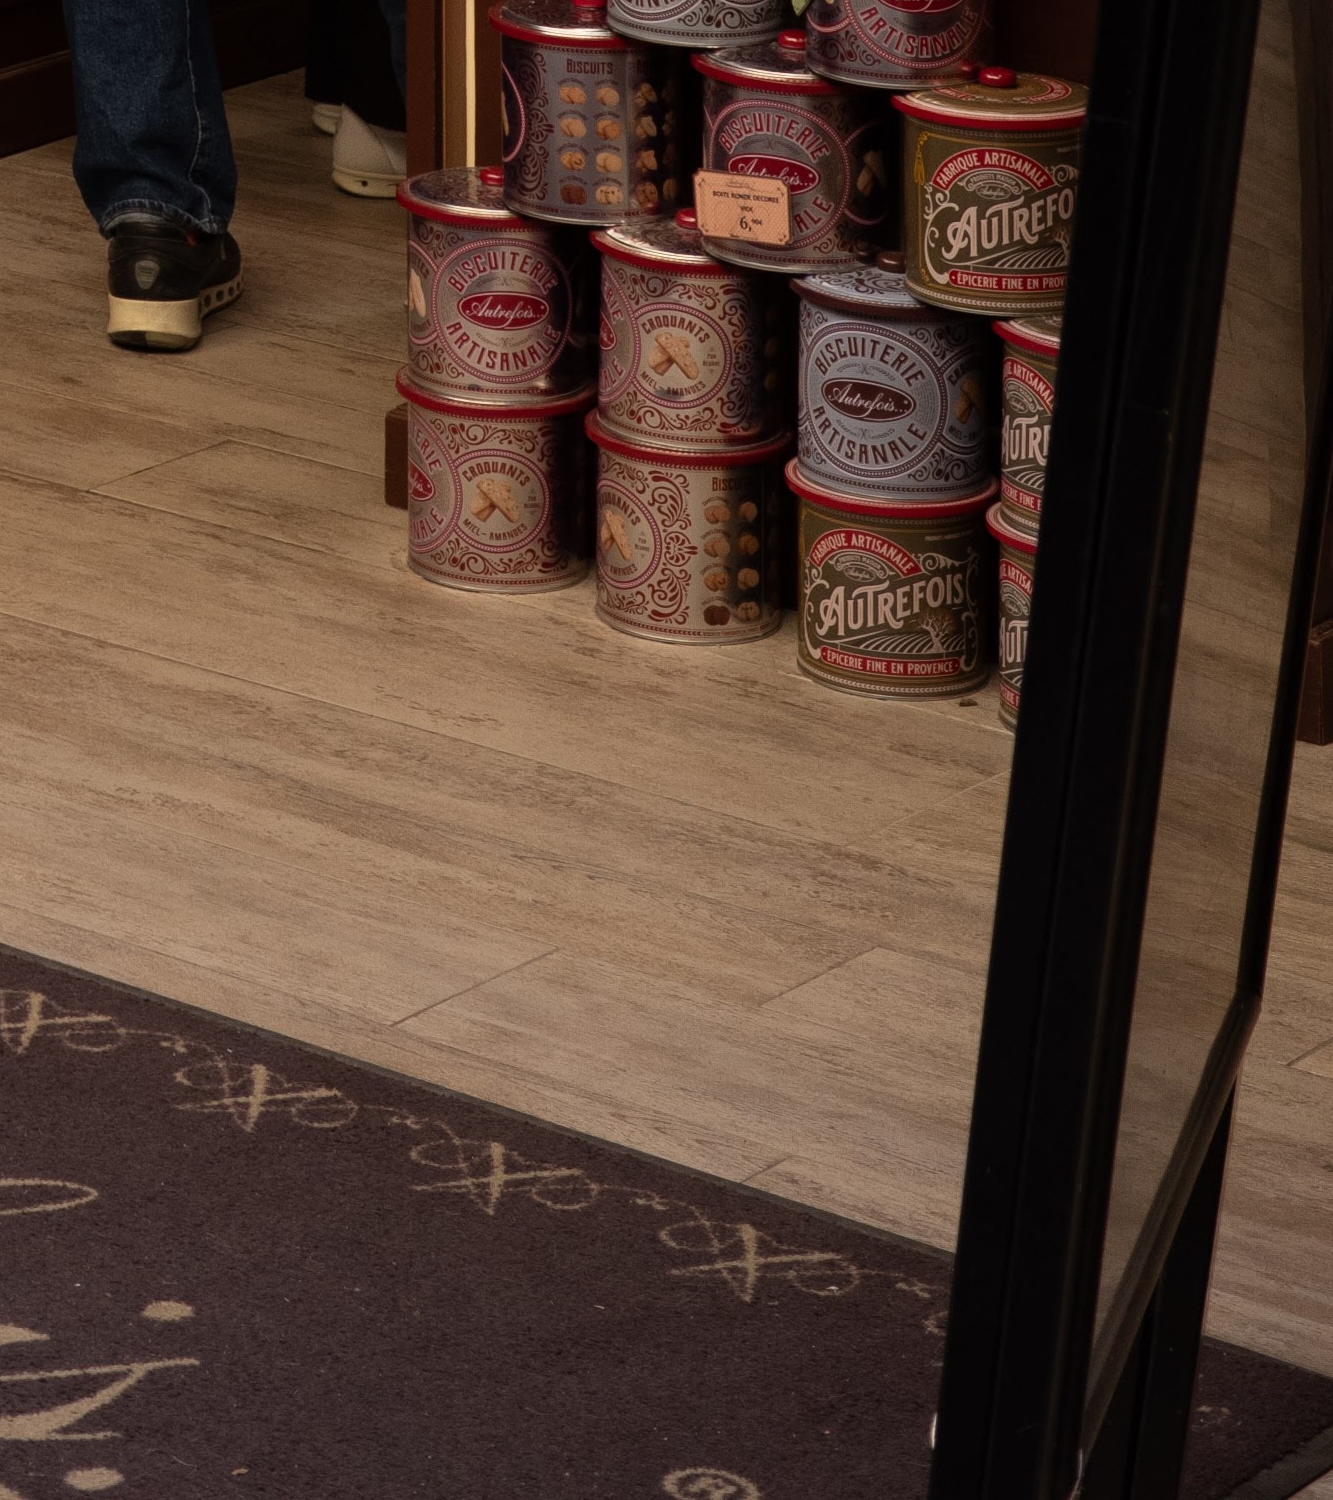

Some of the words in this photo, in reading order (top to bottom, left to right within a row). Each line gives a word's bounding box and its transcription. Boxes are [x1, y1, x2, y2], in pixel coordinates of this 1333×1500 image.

[859, 7, 979, 59] ARTISANALE
[566, 57, 614, 75] BISCUITS
[720, 112, 829, 159] BISCUITERIE
[934, 152, 981, 190] FABRIQUE
[983, 151, 1048, 187] ARTISANALE
[448, 251, 557, 294] BISCUITERIE
[956, 271, 997, 288] ÉPICERIE
[1001, 274, 1023, 289] FINE
[1027, 276, 1040, 290] EN
[446, 321, 563, 372] ARTISANALE
[641, 316, 709, 344] CROQUANTS
[815, 337, 926, 387] BISCUITERIE
[813, 406, 928, 466] ARTISANALE
[462, 464, 530, 488] CROQUANTS
[812, 533, 849, 566] FABRIQUE
[851, 533, 915, 574] ARTISANALE
[817, 572, 965, 638] AUTREFOIS
[826, 649, 864, 669] ÉPICERIE
[866, 658, 887, 673] FINE
[890, 661, 904, 674] EN
[907, 660, 954, 674] PROVENCE
